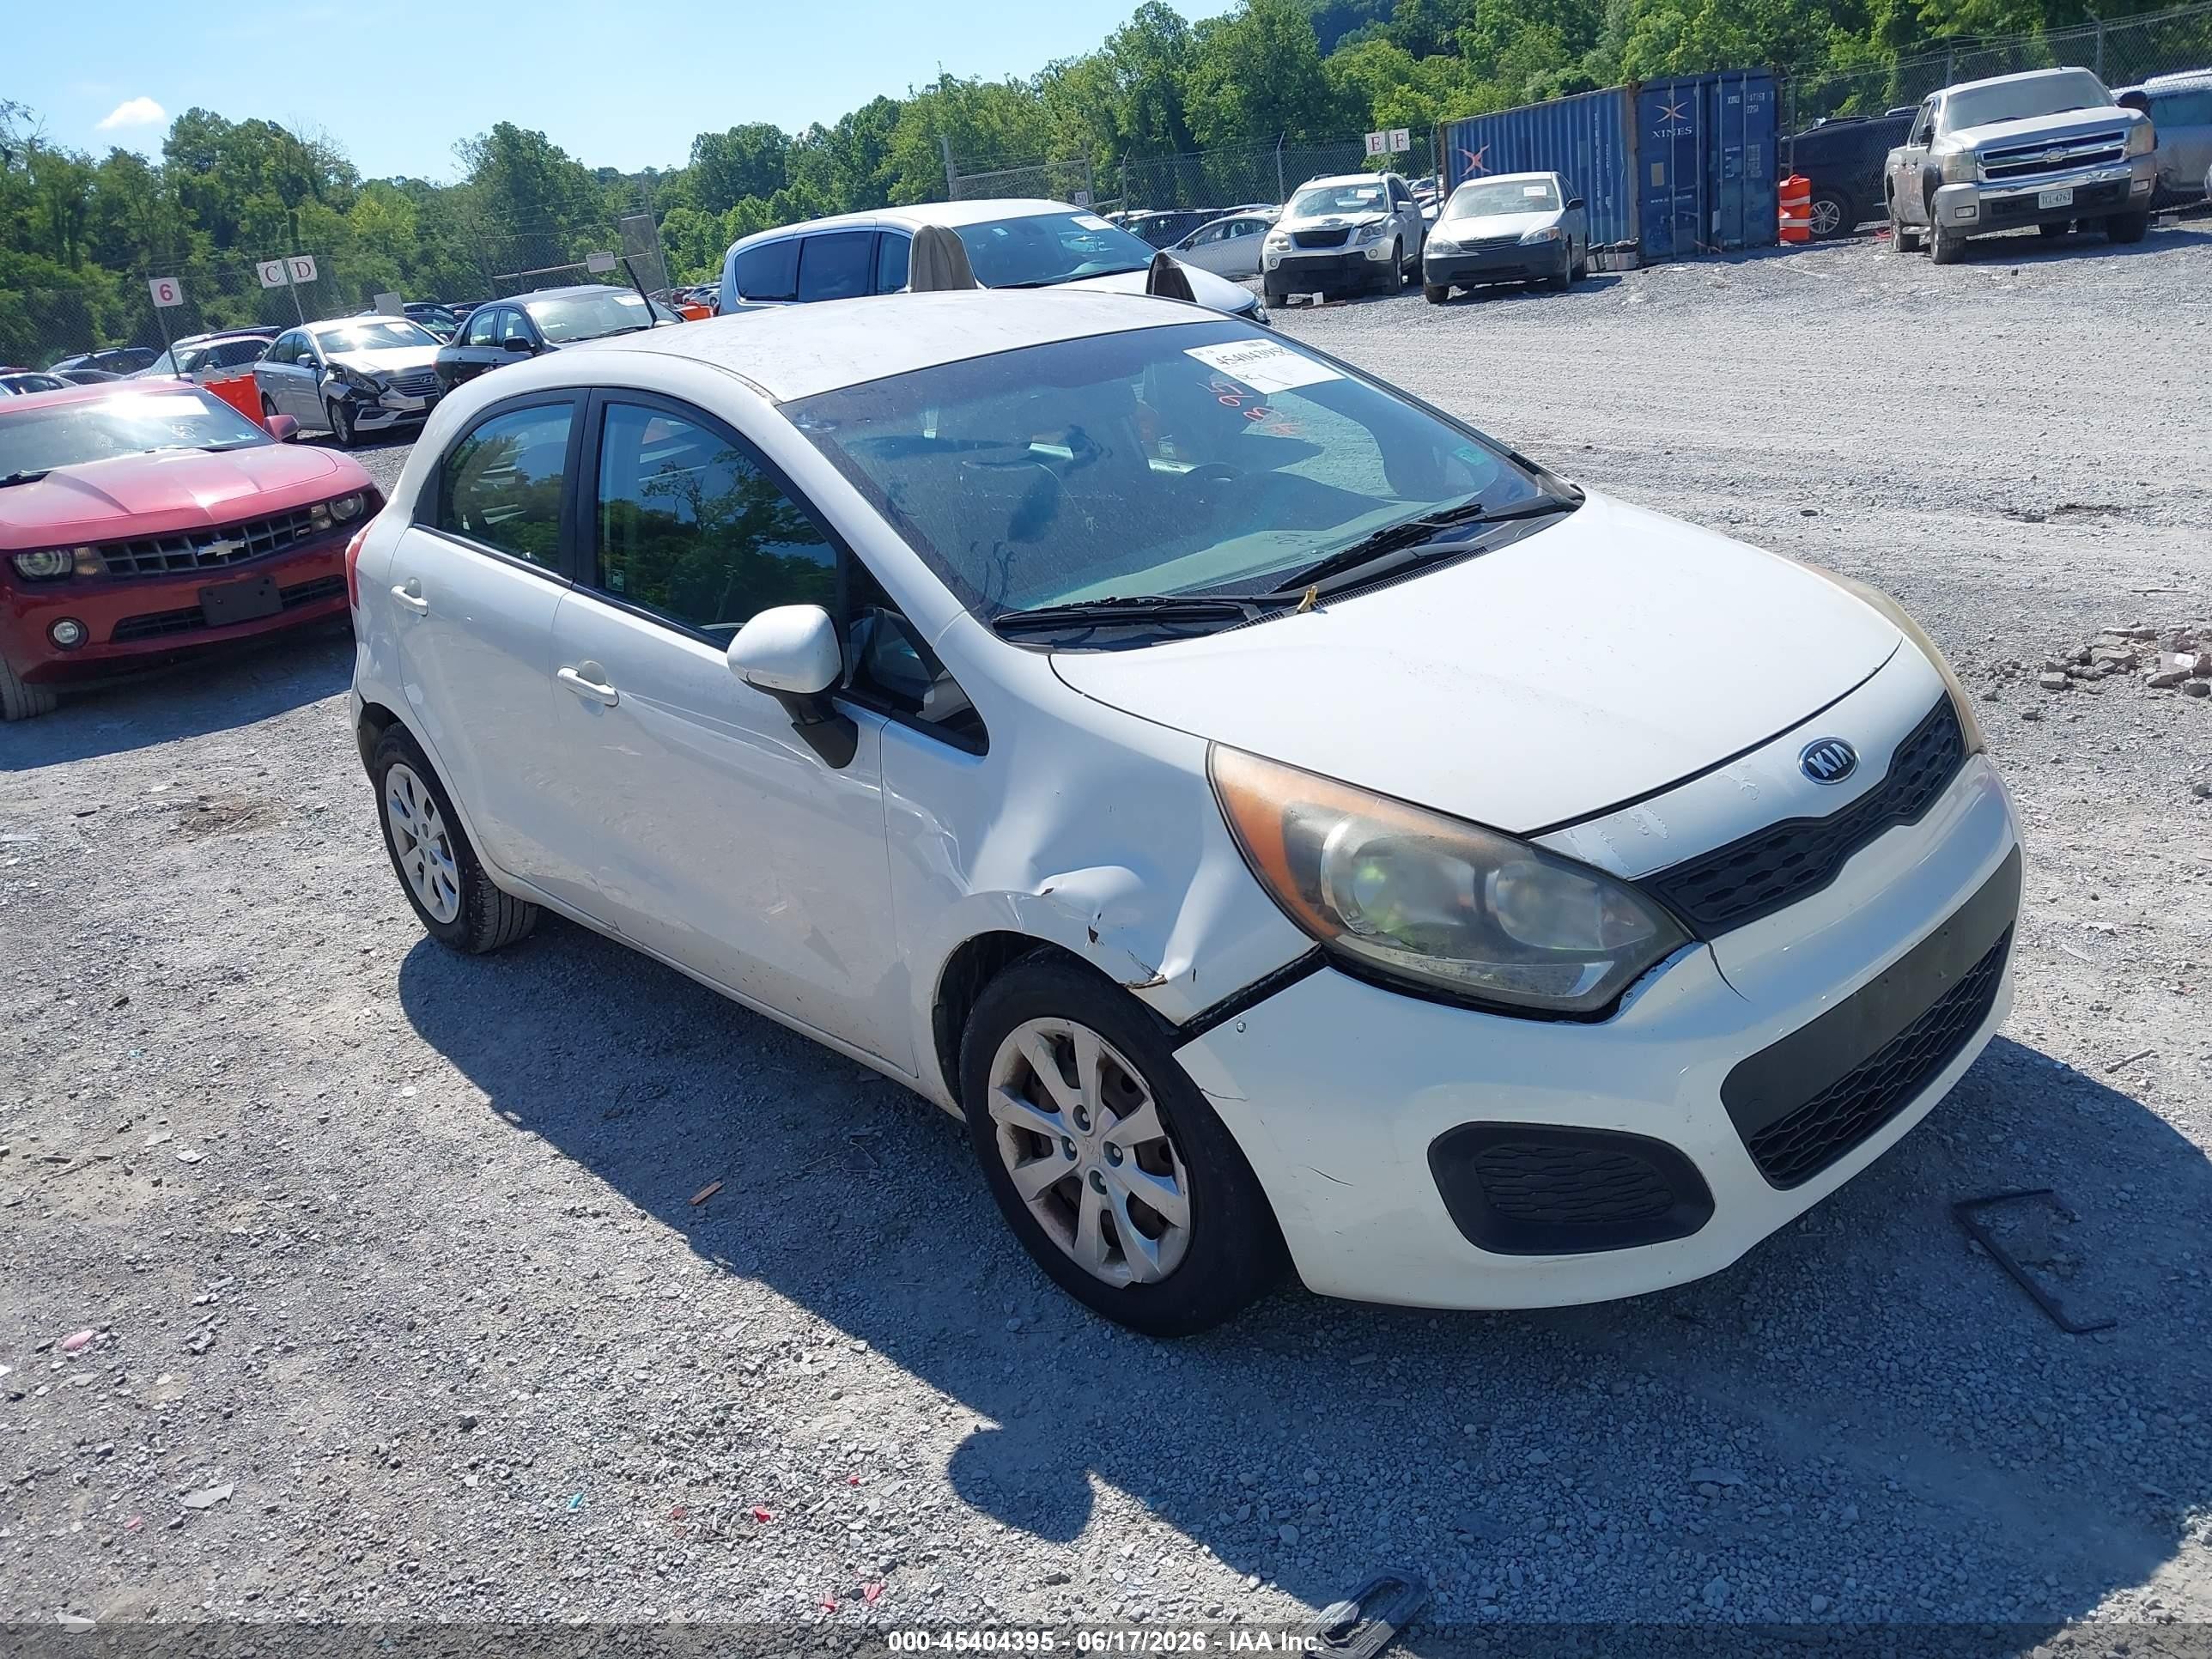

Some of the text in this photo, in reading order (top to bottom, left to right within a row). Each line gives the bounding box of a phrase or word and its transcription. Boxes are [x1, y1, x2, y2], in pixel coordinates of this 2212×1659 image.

[1395, 132, 1404, 148] F
[1651, 125, 1692, 138] XINES
[1370, 137, 1382, 151] E
[265, 265, 281, 283] C
[292, 261, 311, 278] D
[159, 283, 173, 301] 6
[1807, 743, 1855, 778] KIA
